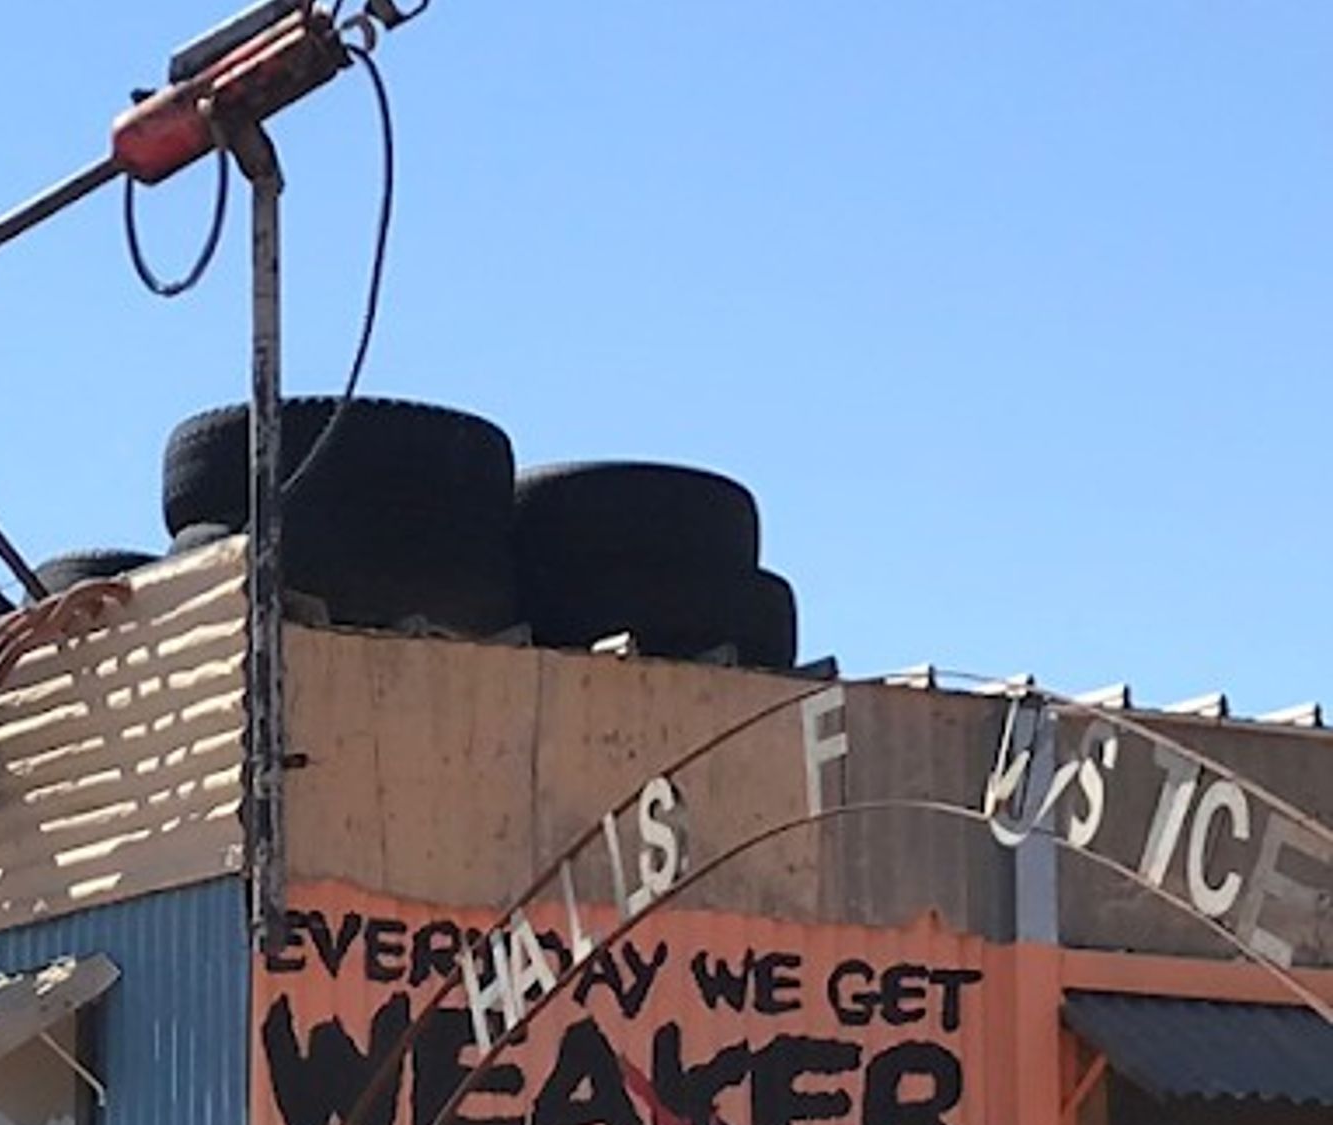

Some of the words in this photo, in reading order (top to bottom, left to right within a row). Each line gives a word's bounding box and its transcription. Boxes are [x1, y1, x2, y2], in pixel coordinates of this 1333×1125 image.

[455, 775, 679, 1054] HALLS
[690, 945, 803, 1016] WE
[827, 958, 983, 1033] GET
